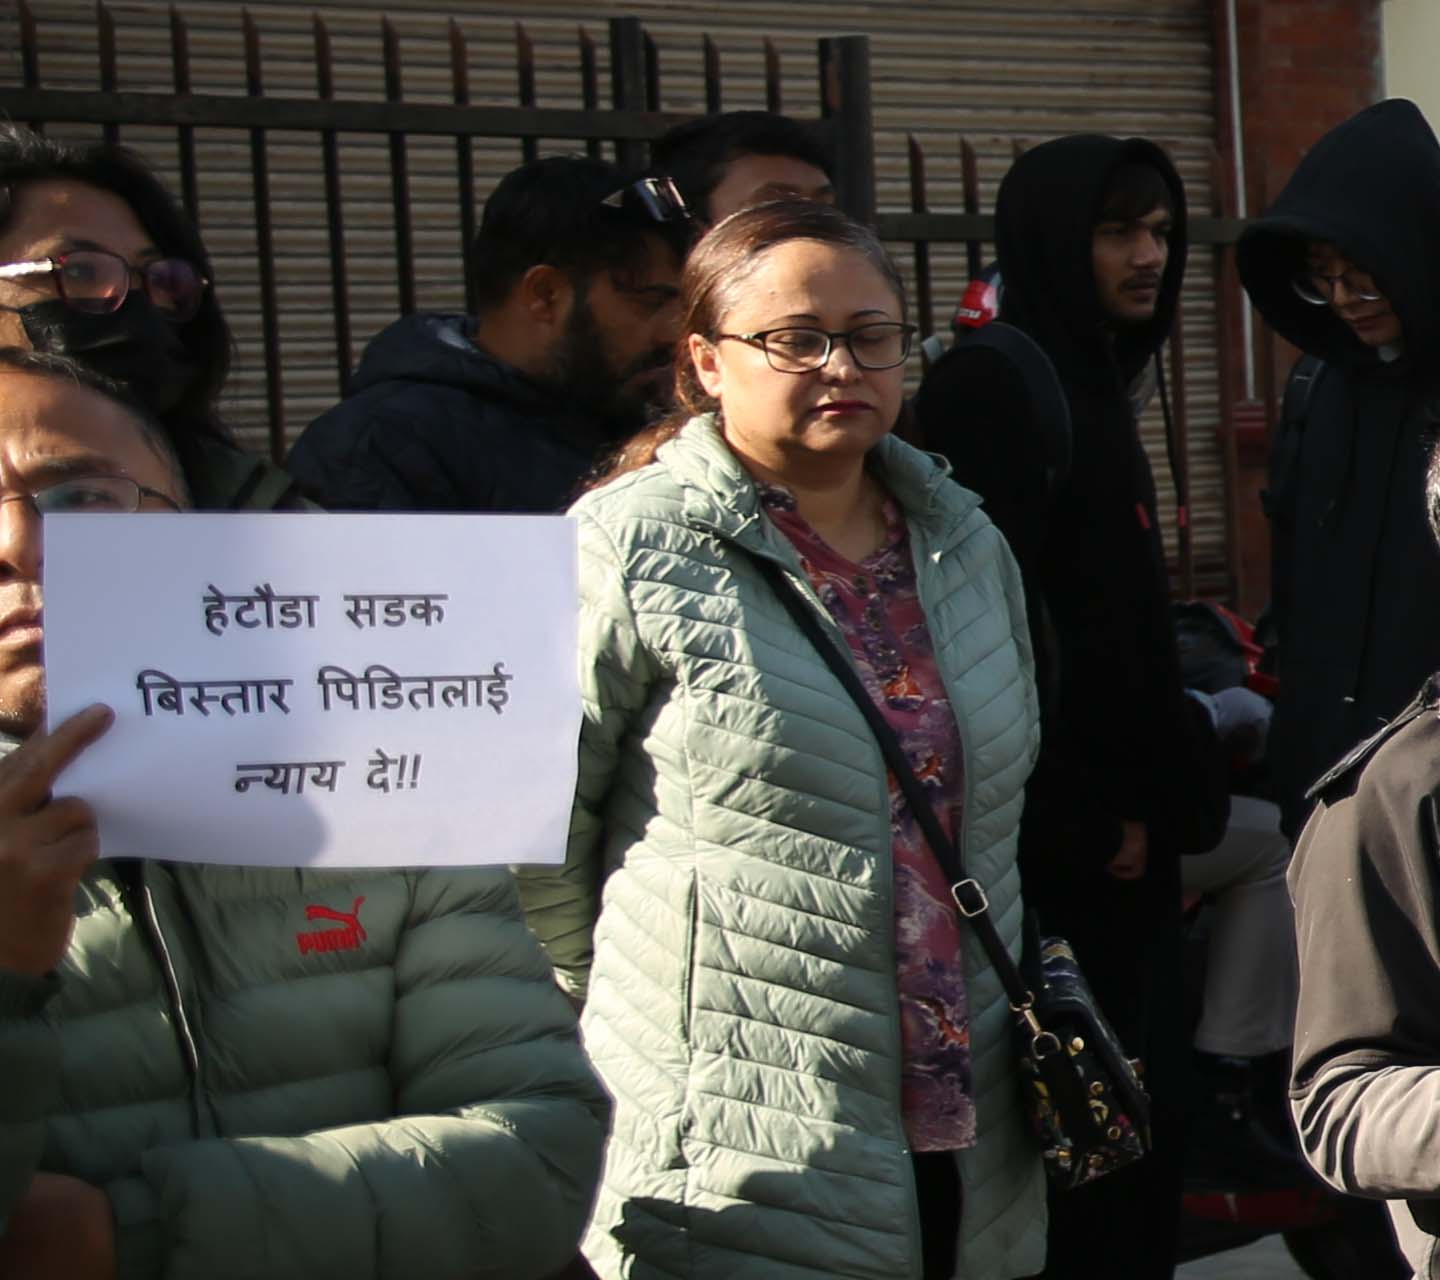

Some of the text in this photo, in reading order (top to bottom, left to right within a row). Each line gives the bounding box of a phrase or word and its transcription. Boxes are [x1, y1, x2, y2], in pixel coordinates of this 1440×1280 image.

[202, 584, 449, 636] हेटौडा सडक
[136, 662, 514, 716] बिस्तार पिडितलाई
[234, 748, 423, 795] न्याय दे!!
